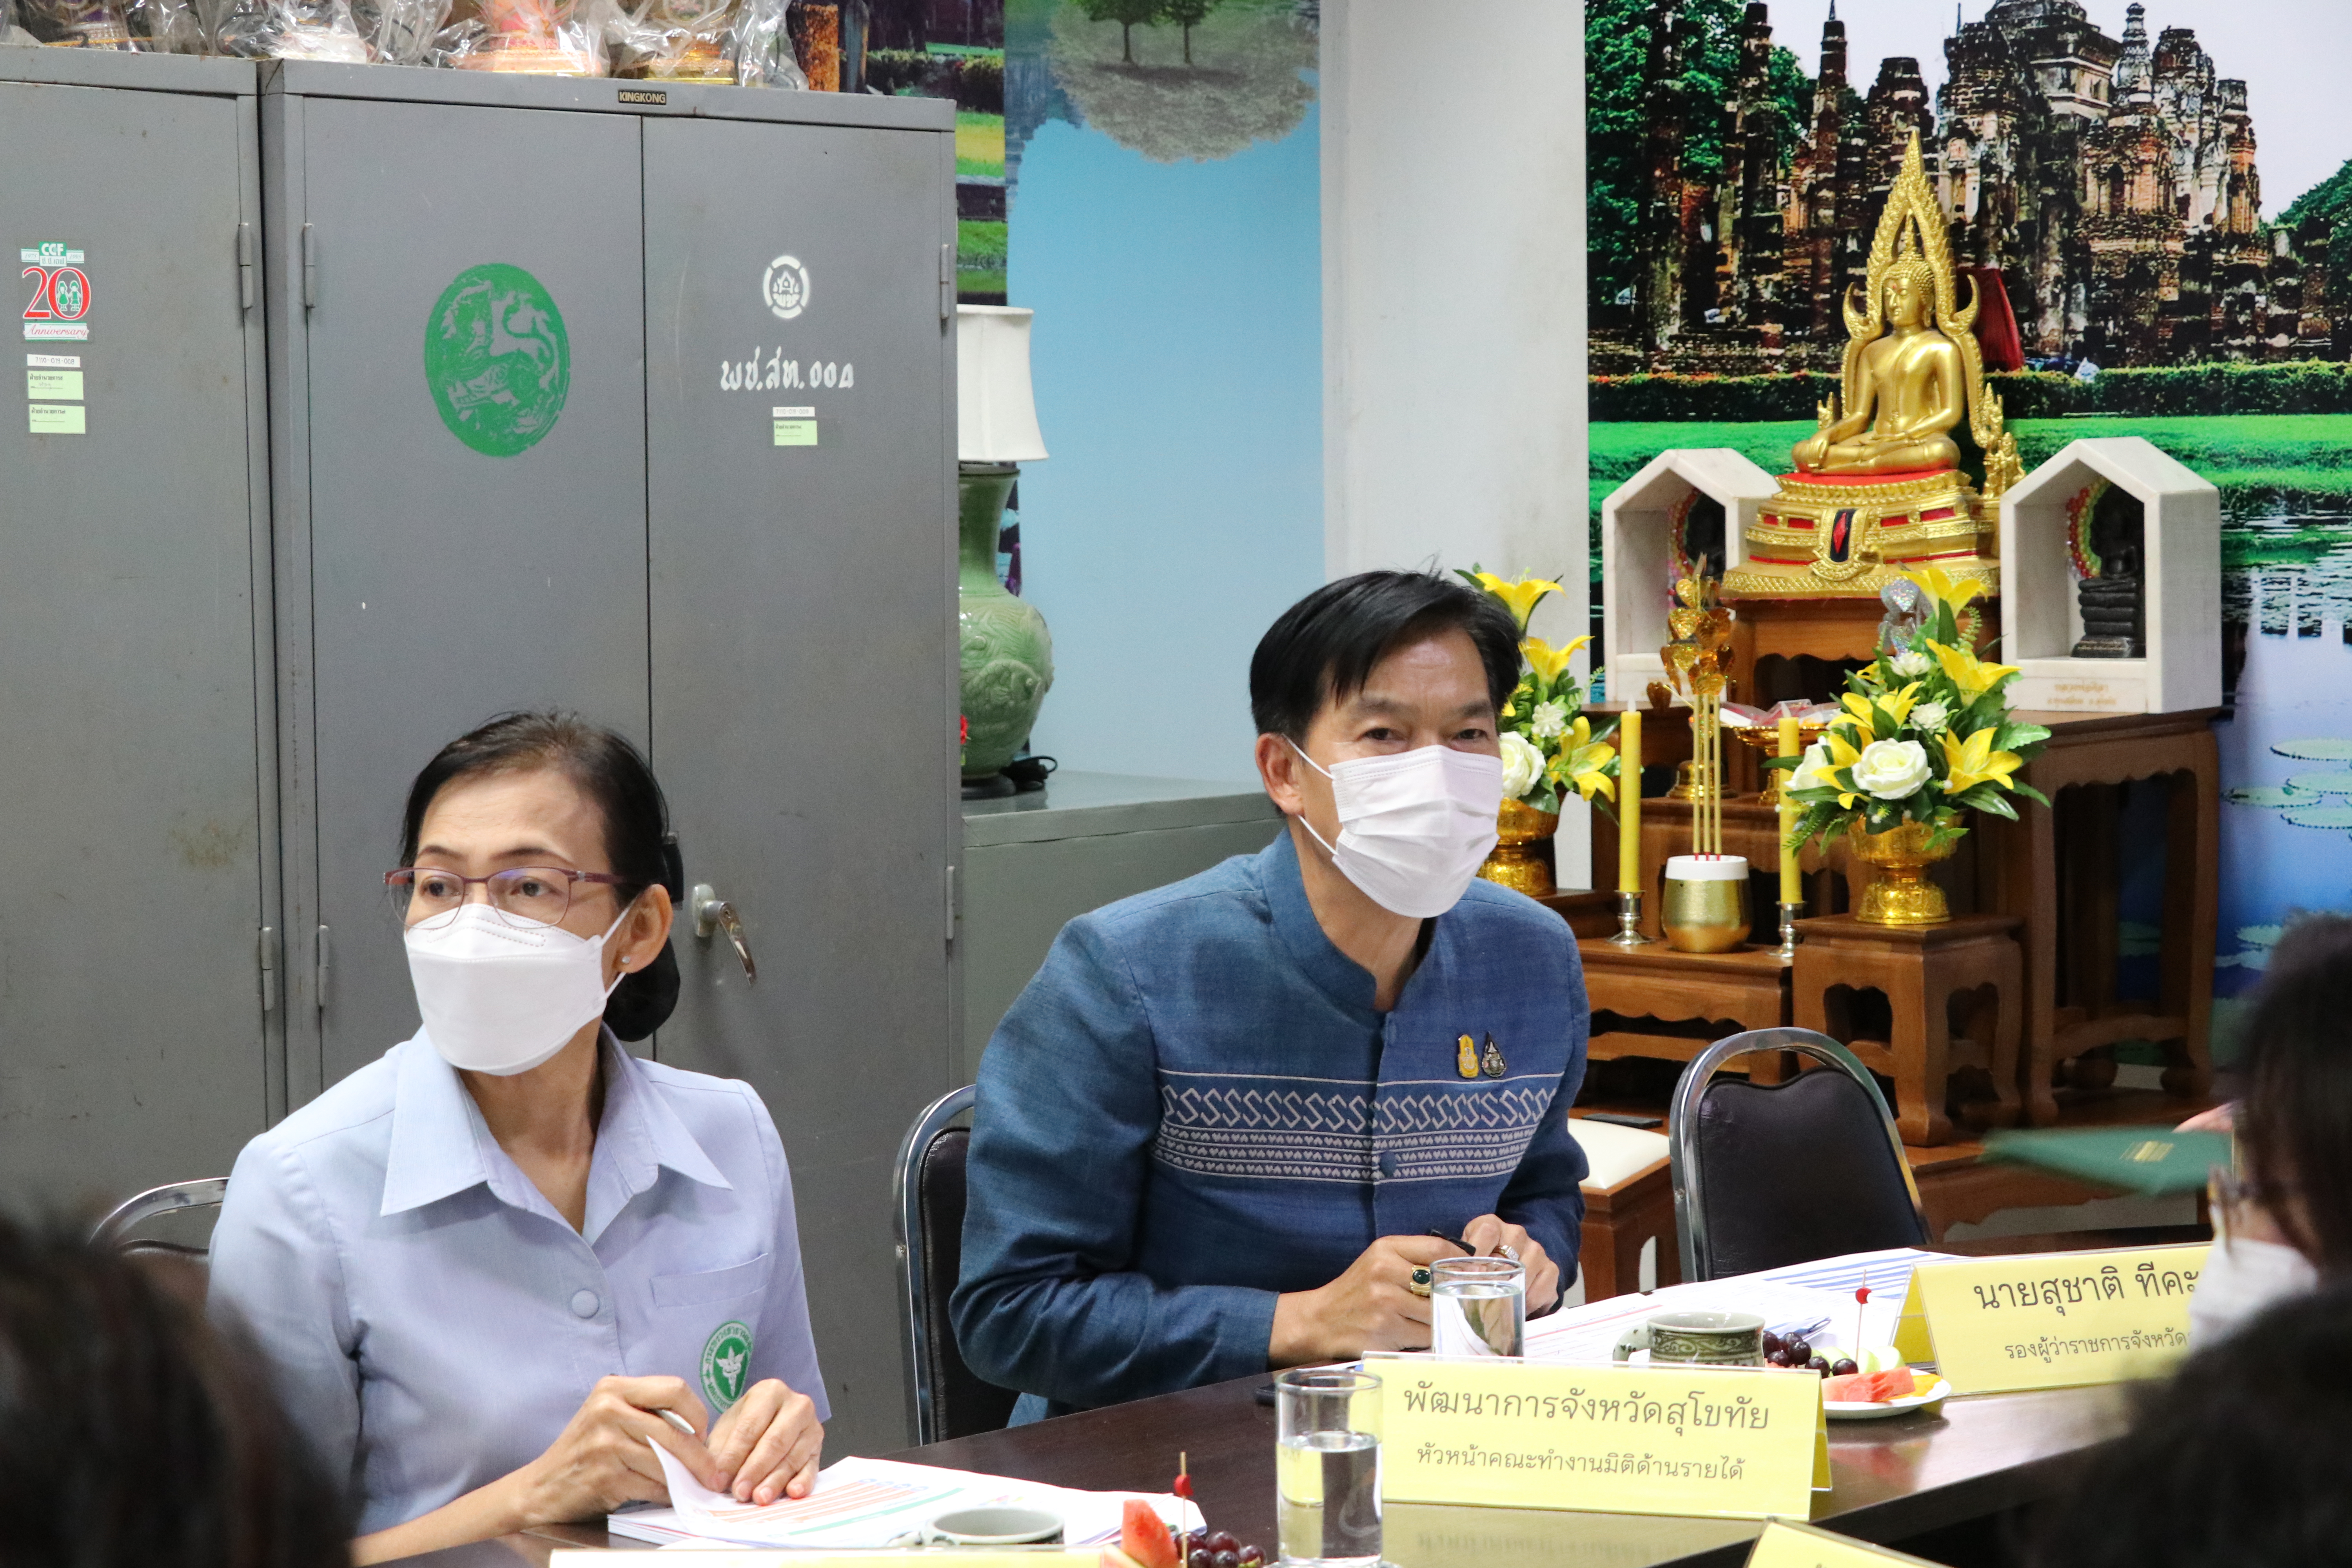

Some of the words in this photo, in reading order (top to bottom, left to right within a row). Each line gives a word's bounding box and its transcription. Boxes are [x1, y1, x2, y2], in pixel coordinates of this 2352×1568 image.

[619, 91, 666, 103] KINGKONG
[41, 243, 64, 256] CCF
[22, 266, 91, 321] 20
[24, 324, 87, 339] Anniversary
[1973, 1265, 2125, 1316] นายสุชาติ
[2005, 1327, 2190, 1363] รองผู้ว่าราชการจังหวัด
[1404, 1380, 1769, 1437] พัฒนาการจังหวัดสุโขทัย
[1417, 1442, 1746, 1480] หัวหน้าคณะทำงานมิติด้านรายได้
